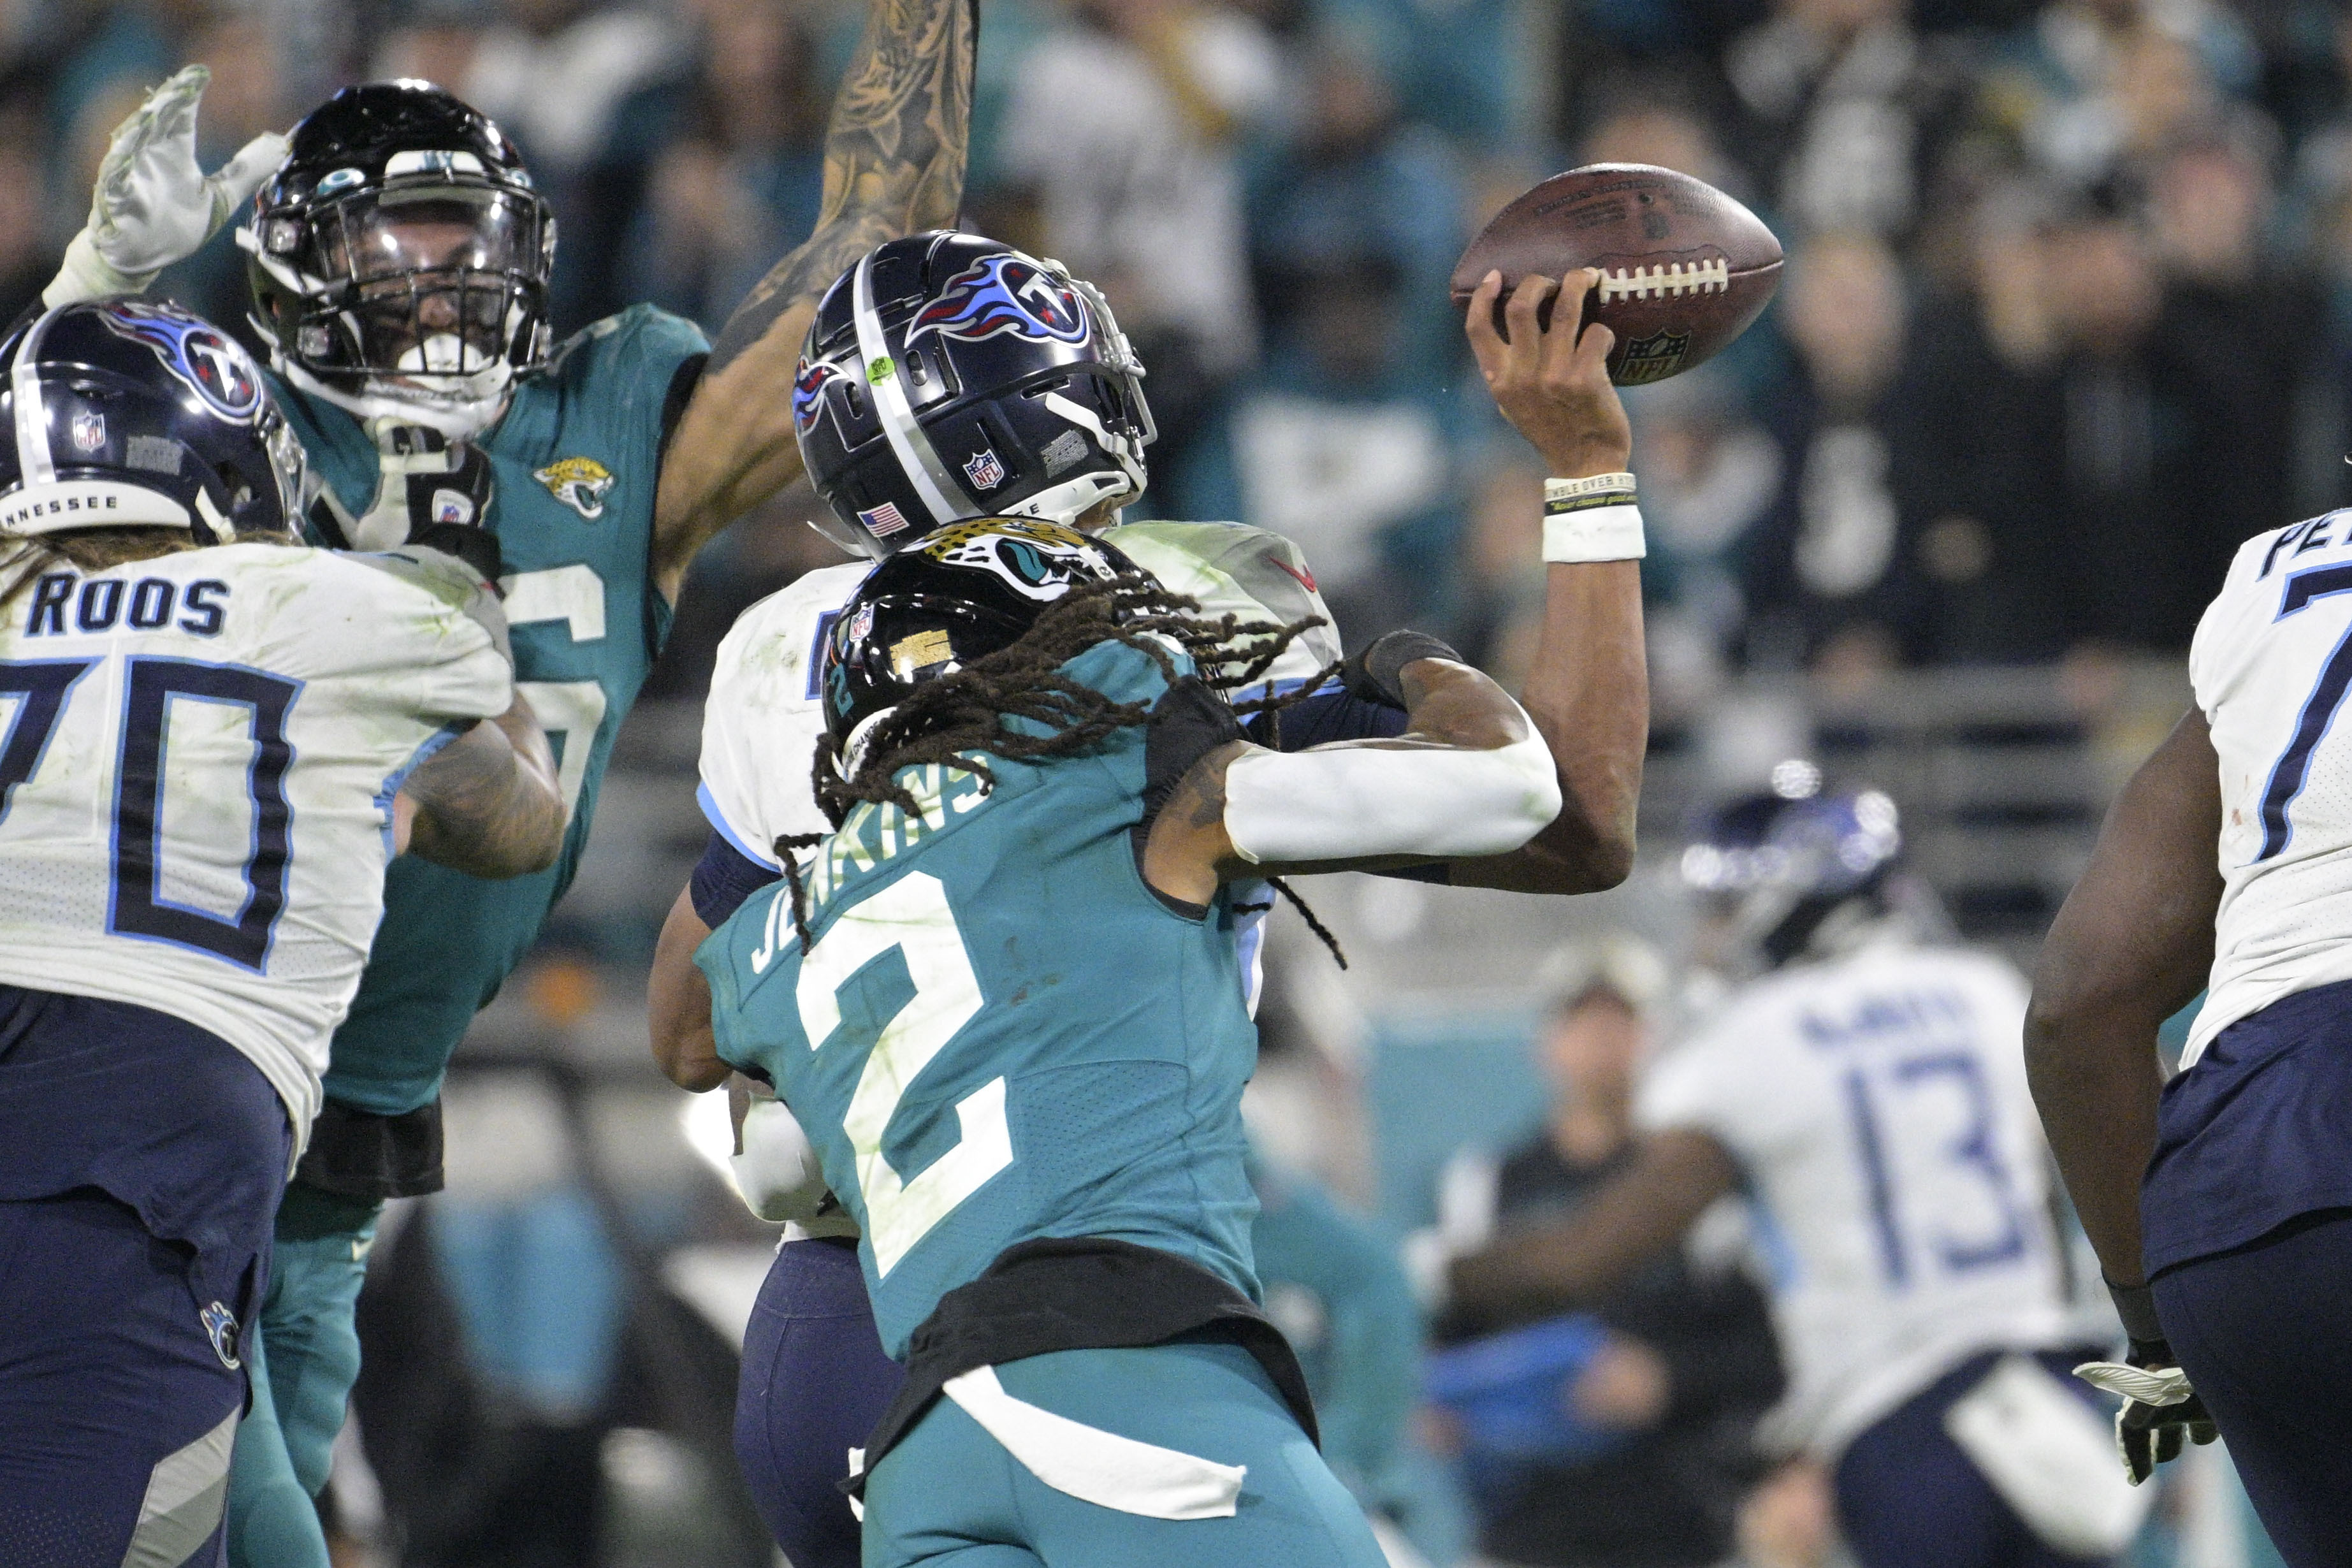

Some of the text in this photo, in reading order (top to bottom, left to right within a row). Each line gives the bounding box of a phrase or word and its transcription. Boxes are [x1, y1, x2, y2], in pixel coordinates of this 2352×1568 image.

[975, 465, 999, 485] NFL
[1582, 476, 1614, 491] OVER
[24, 572, 231, 639] ROOS
[852, 618, 869, 636] NFL
[830, 662, 854, 718] 2
[0, 654, 305, 976] 70
[795, 869, 1014, 1280] 2
[1841, 1049, 2030, 1289] 13
